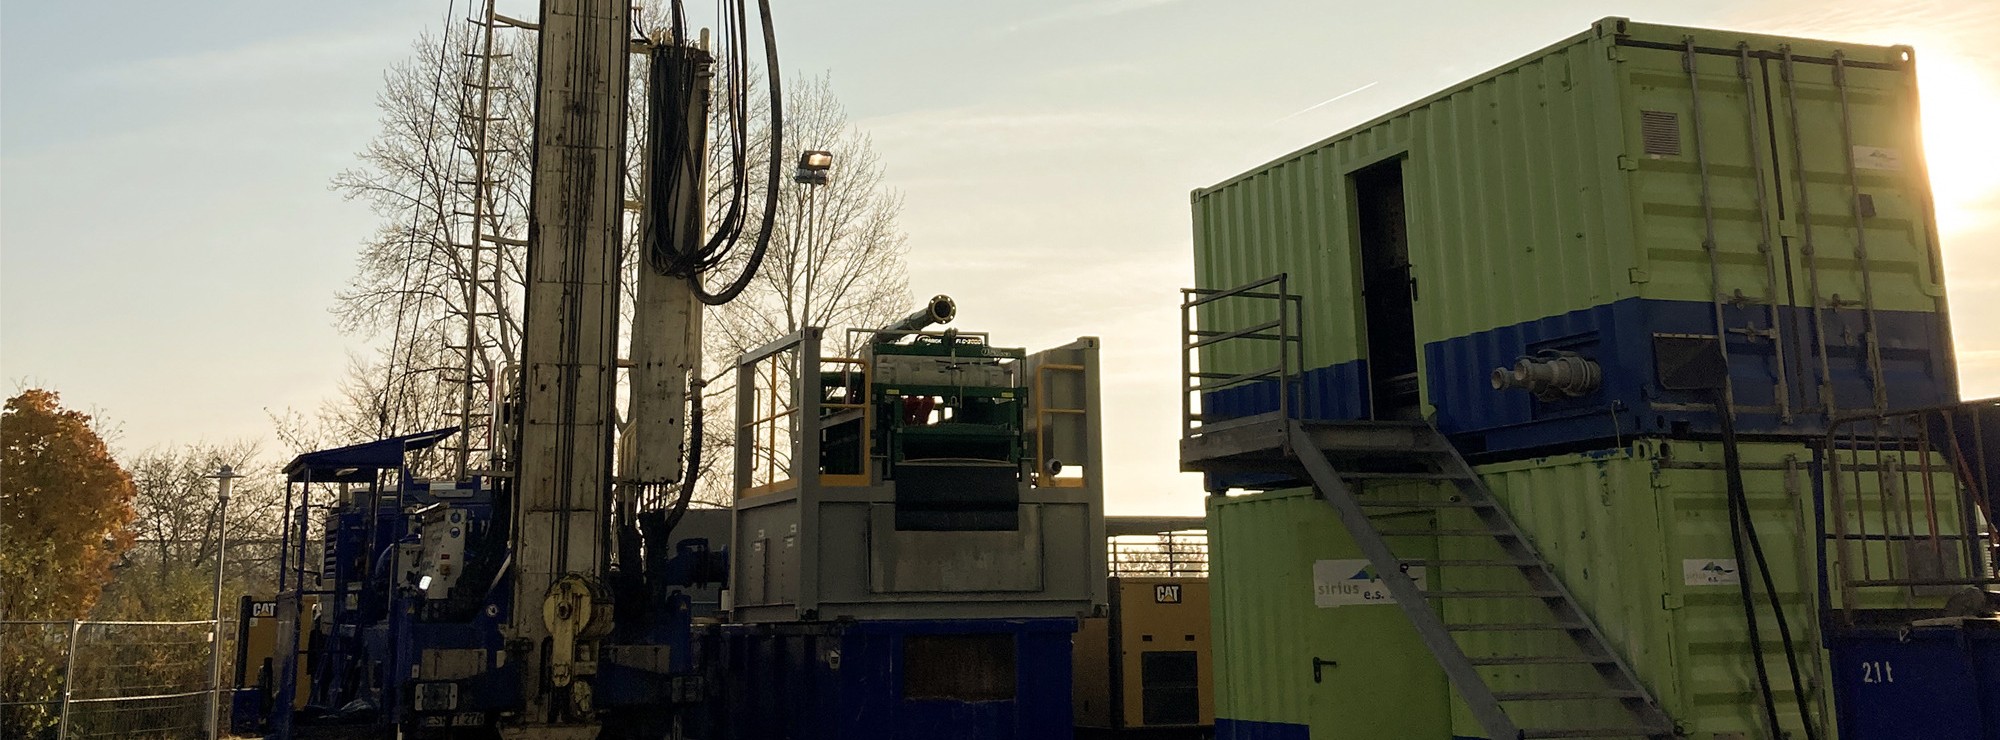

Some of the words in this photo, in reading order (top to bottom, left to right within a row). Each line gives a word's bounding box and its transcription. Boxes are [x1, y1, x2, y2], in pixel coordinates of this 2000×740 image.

[1156, 585, 1180, 602] CAT
[1318, 582, 1360, 595] sirius
[1363, 590, 1385, 600] e.s.
[252, 602, 277, 617] CAT
